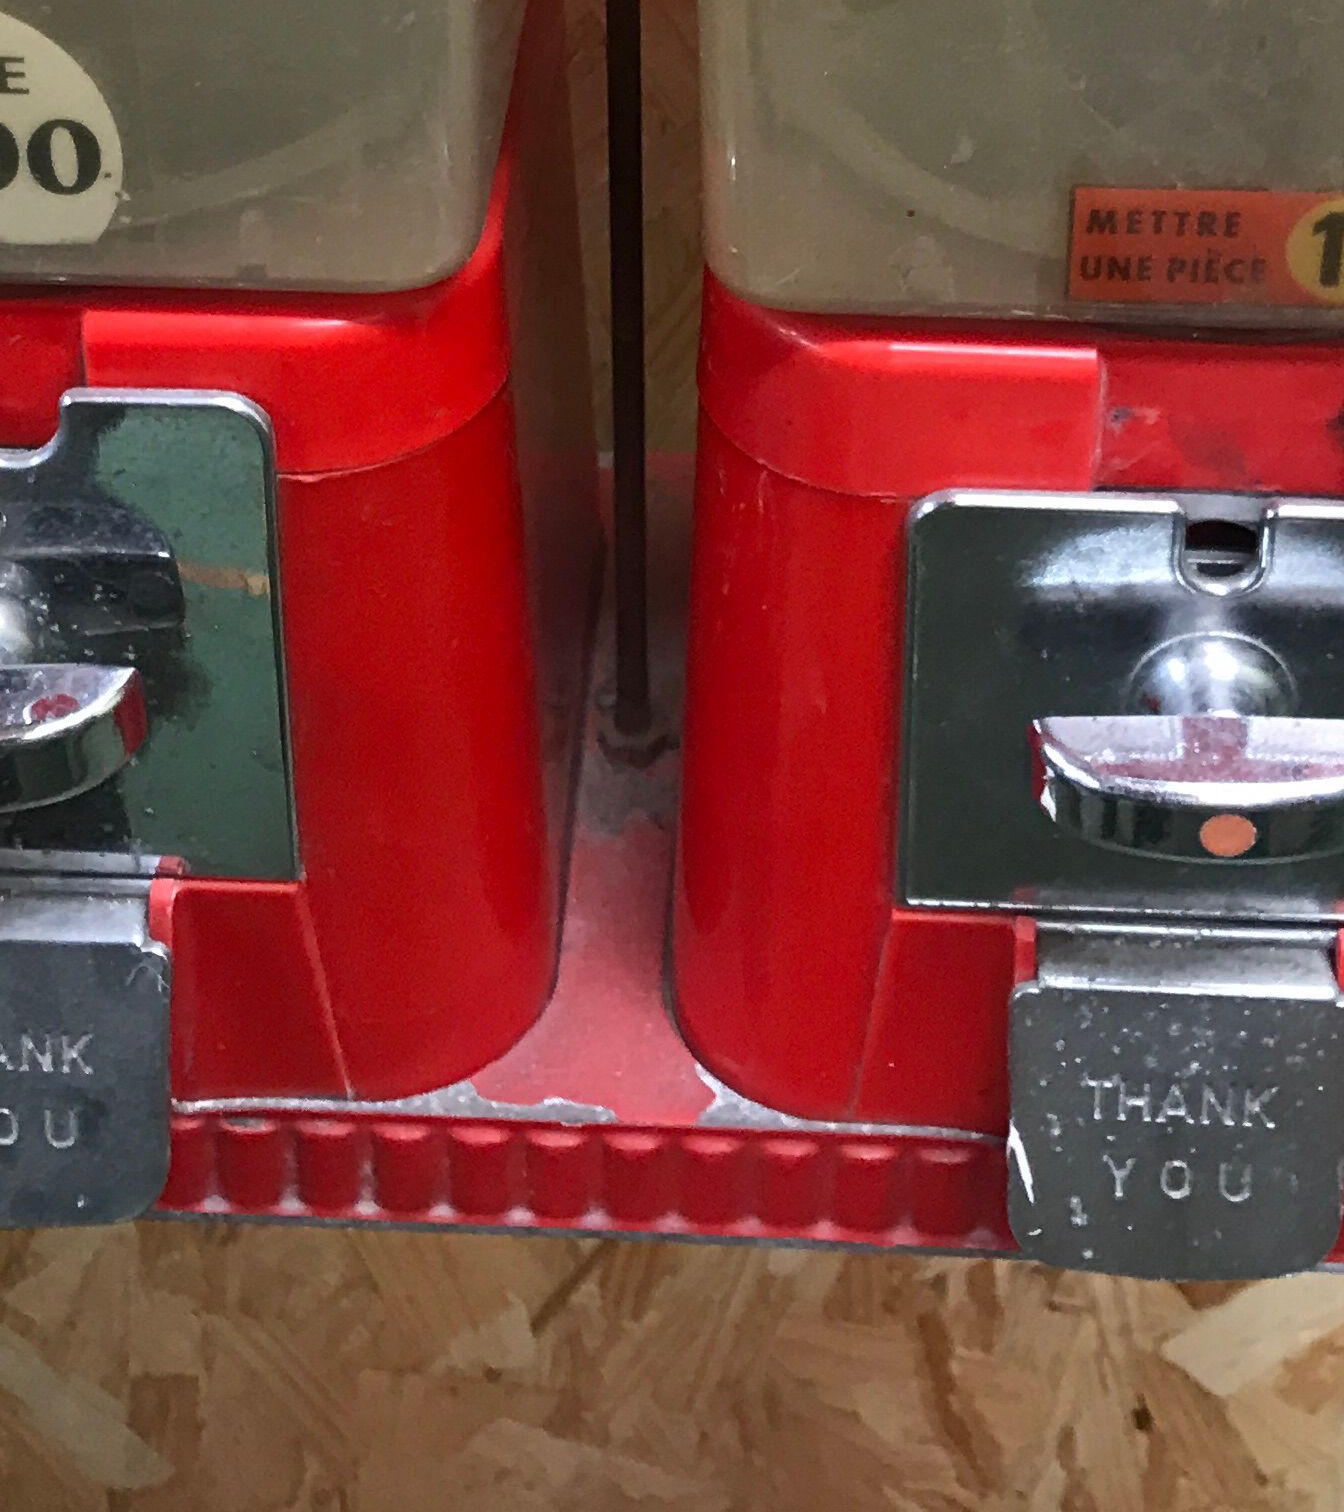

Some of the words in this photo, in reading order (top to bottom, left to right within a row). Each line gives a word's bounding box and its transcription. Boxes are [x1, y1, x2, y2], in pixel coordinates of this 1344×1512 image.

[1087, 209, 1243, 236] METTRE
[1081, 256, 1151, 281] UNE
[1083, 1074, 1279, 1129] THANK
[1103, 1155, 1252, 1203] YOU
